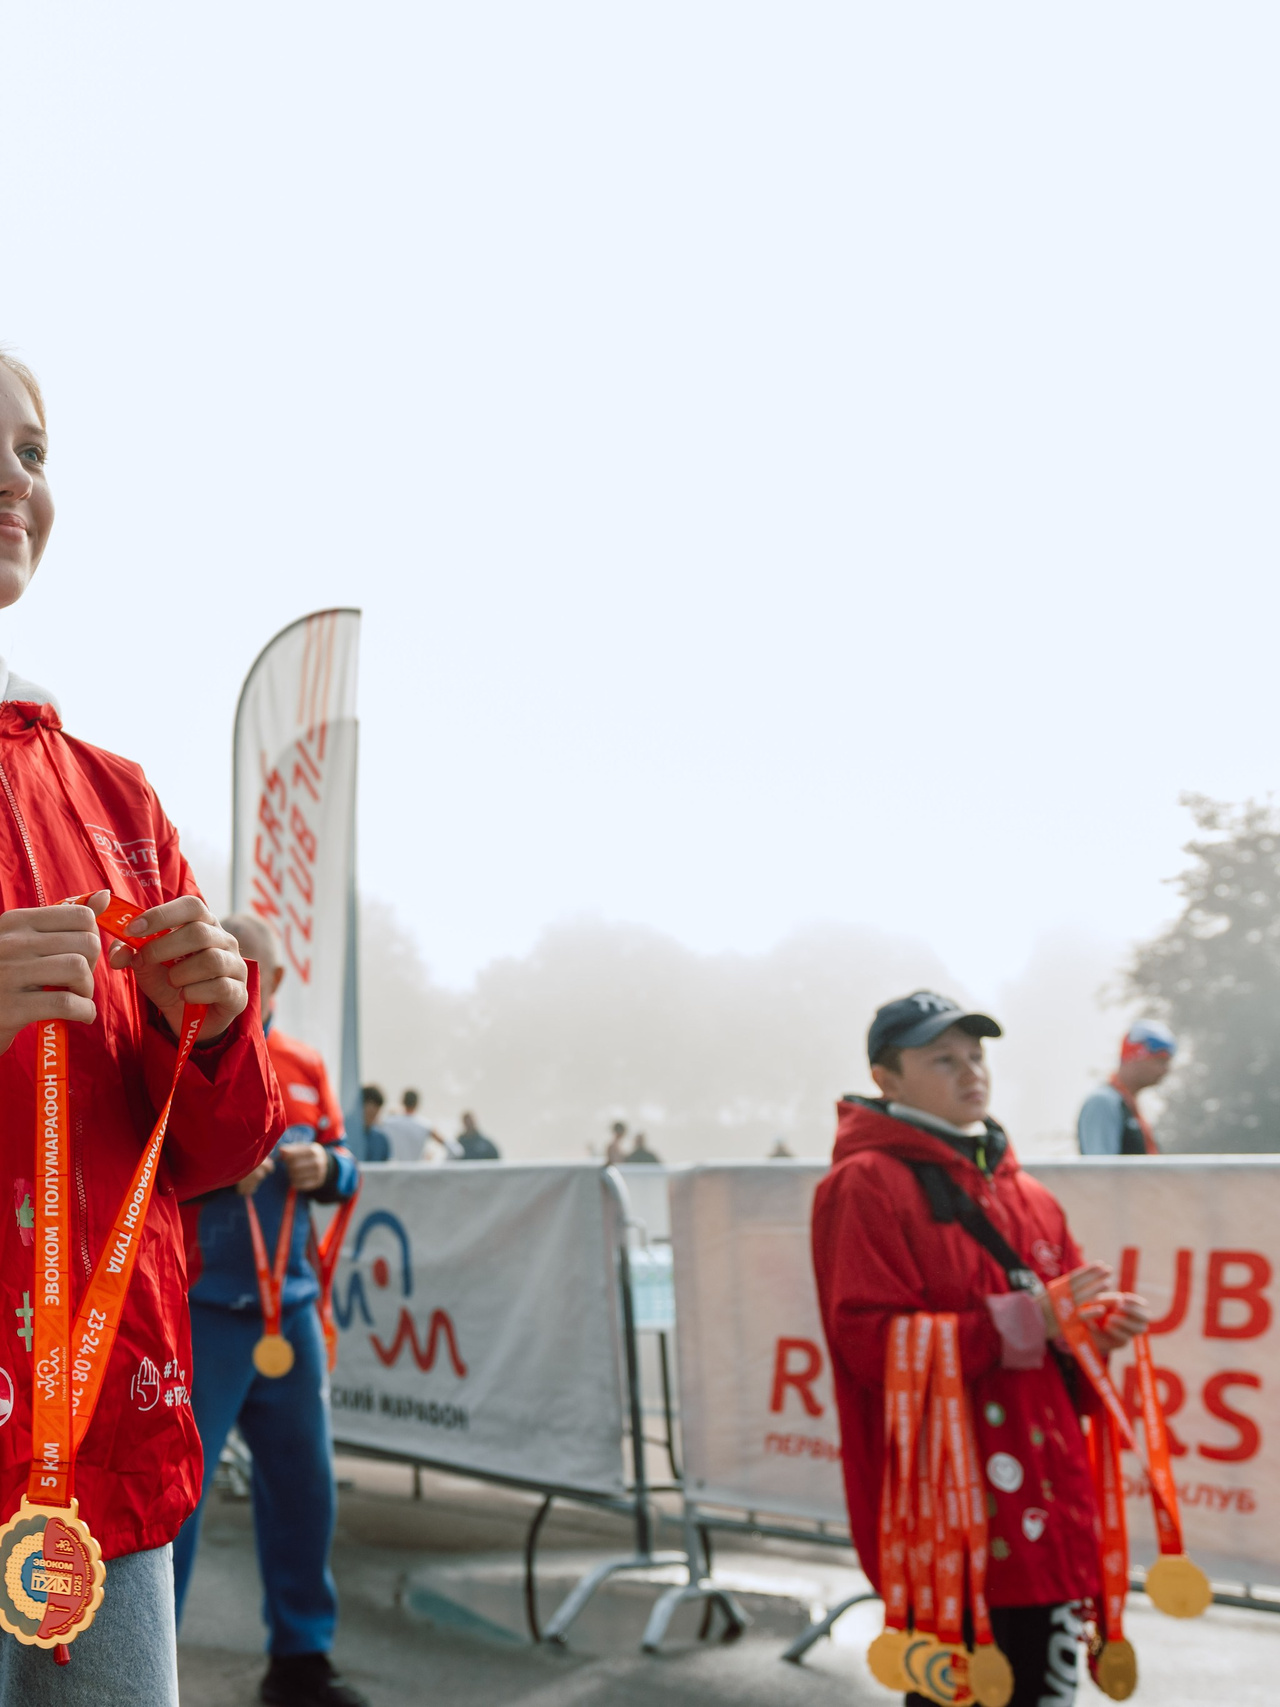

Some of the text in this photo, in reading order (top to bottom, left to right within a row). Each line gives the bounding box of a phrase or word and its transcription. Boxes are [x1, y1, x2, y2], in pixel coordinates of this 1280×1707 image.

[43, 1023, 60, 1306] ЭВОКОМ ПОЛУМАРАФОН ТУЛА
[105, 1230, 133, 1274] ТУЛА
[1119, 1247, 1273, 1342] UB
[331, 1385, 373, 1412] СКИЙ
[40, 1442, 60, 1488] 5 КМ
[32, 1558, 74, 1571] ЭВОКОМ
[73, 1574, 83, 1597] 2025
